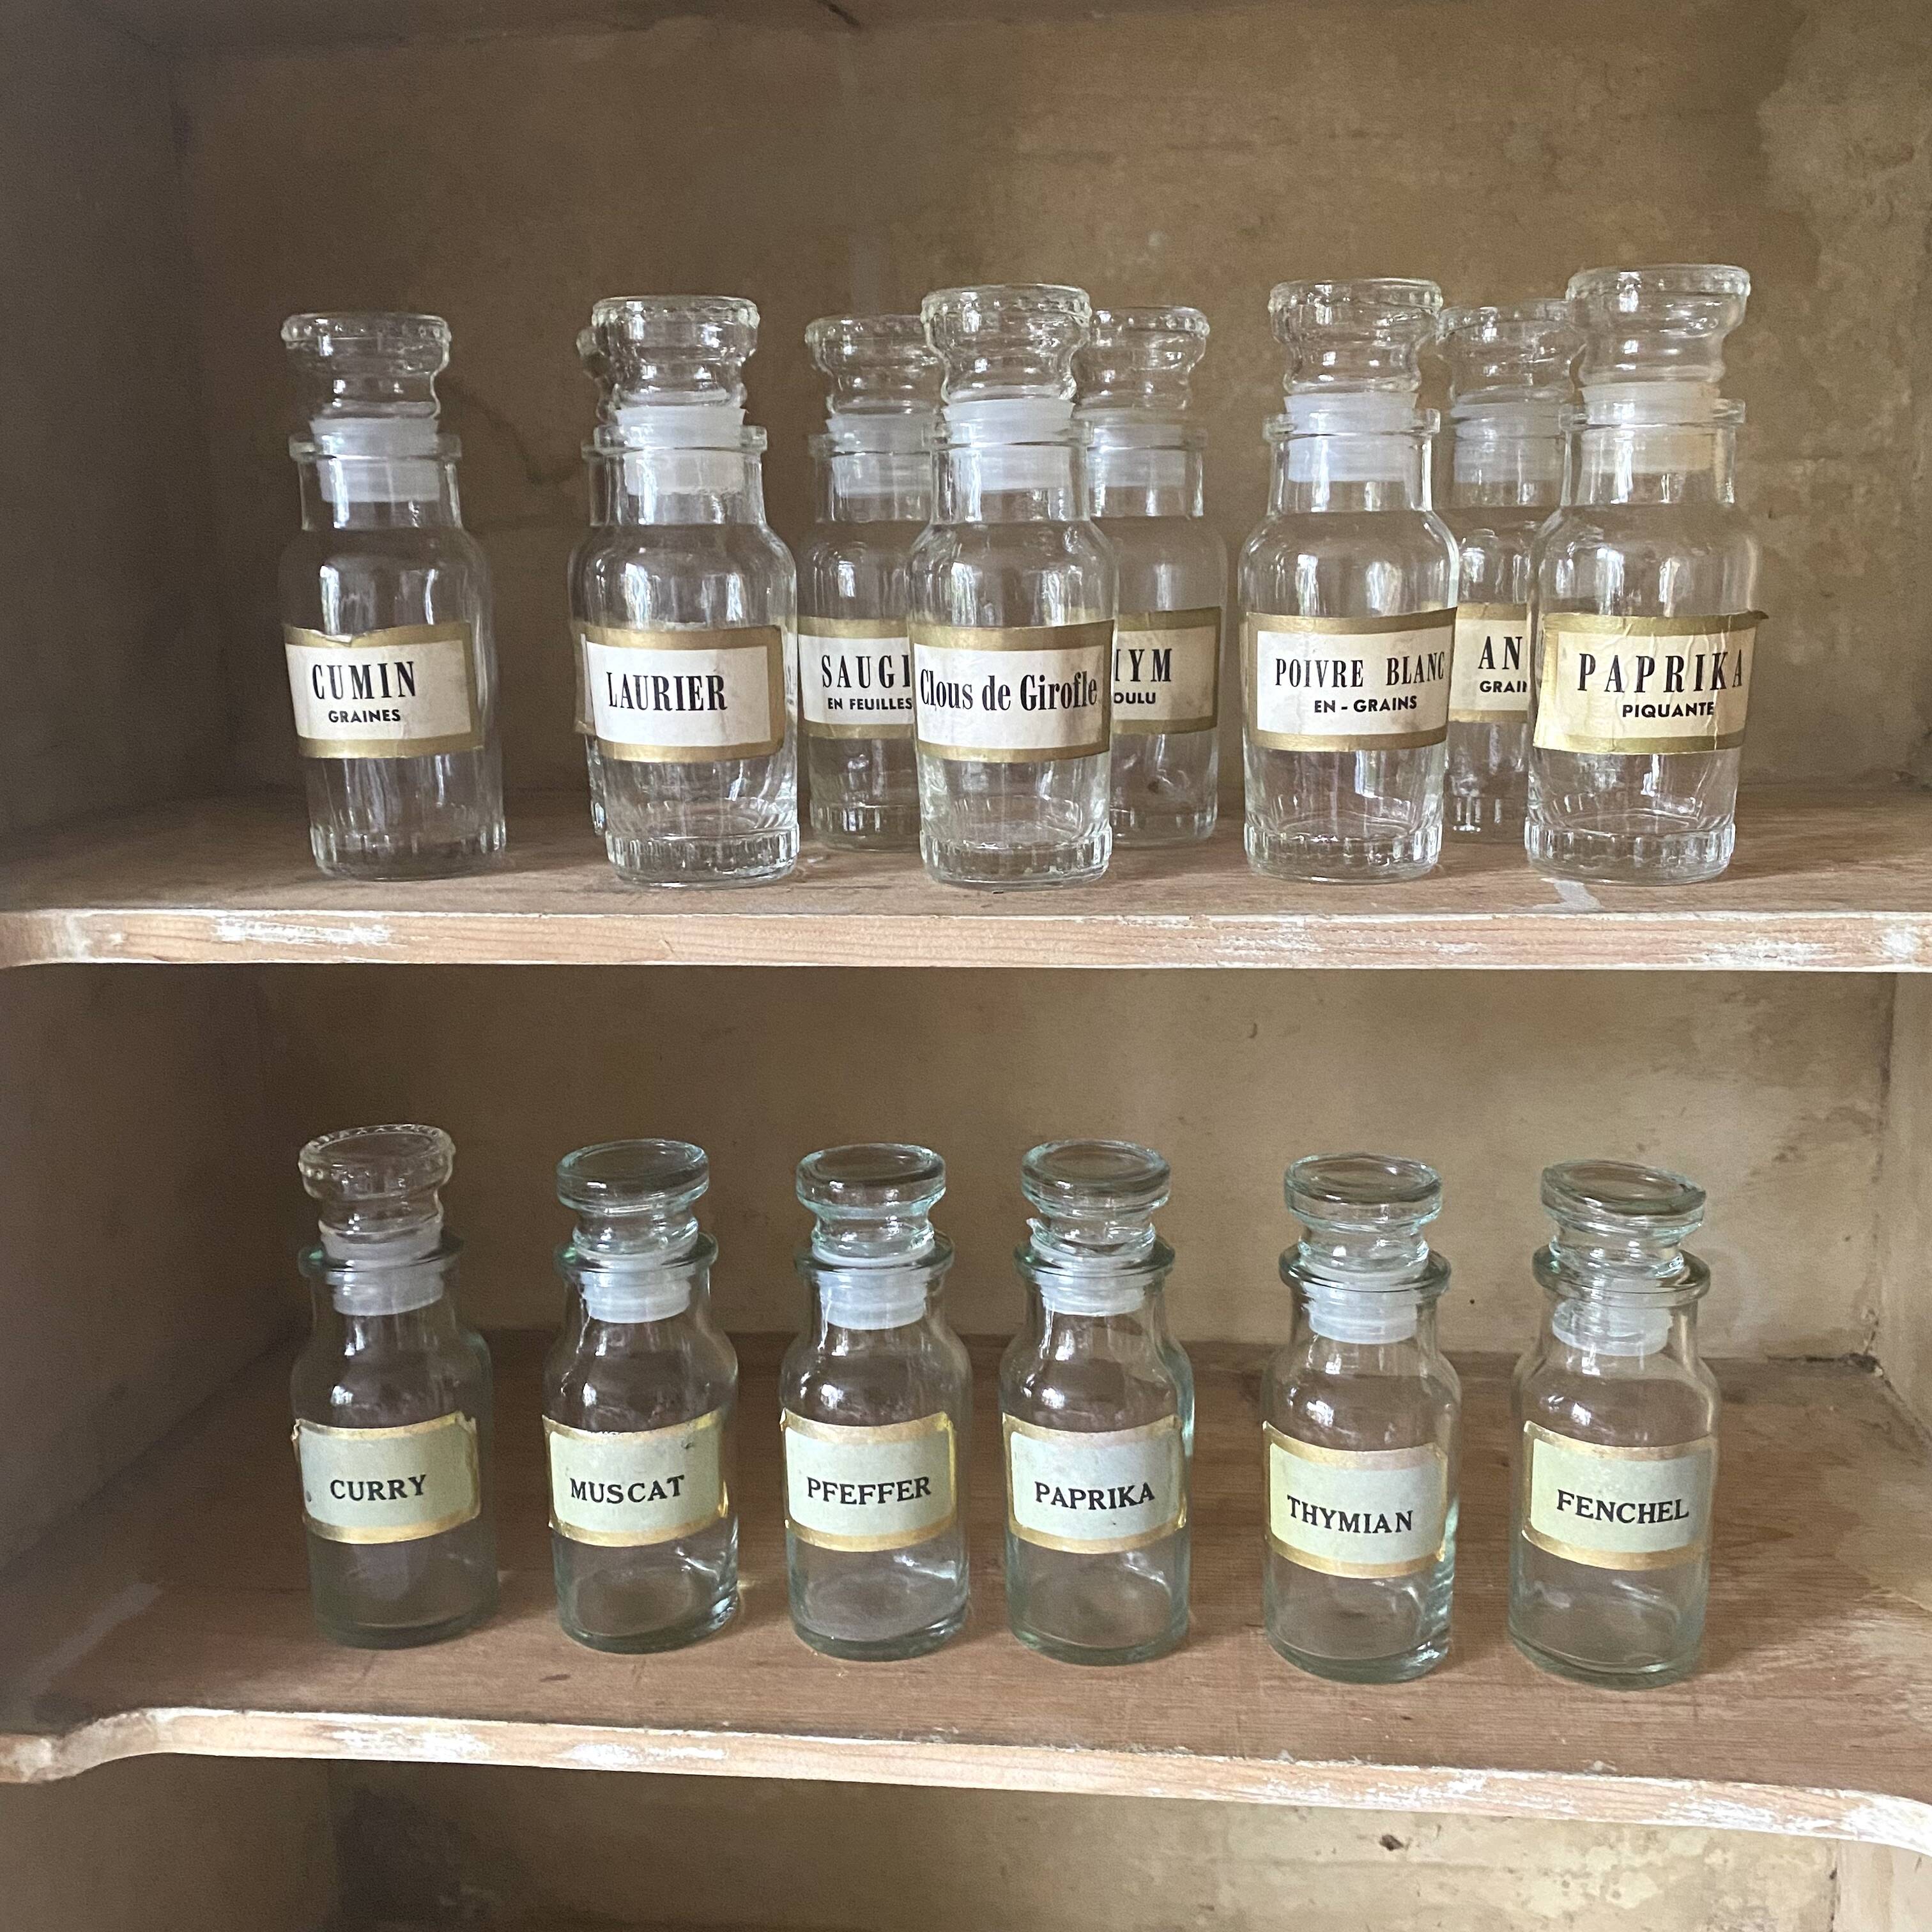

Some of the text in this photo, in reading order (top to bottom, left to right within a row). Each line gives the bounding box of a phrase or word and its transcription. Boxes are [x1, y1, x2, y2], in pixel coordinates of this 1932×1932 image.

[312, 661, 417, 700] CUMIN
[1275, 651, 1445, 688] POIVRE BLANC
[1577, 648, 1742, 693] PAPRIKA
[606, 671, 728, 712] LAURIER
[827, 697, 913, 710] EN FEUILLES
[920, 668, 1098, 712] Clous de Girofle
[328, 709, 401, 723] GRAINES
[1622, 701, 1714, 718] PIQUANTE
[330, 1474, 427, 1501] CURRY
[570, 1474, 685, 1504] MUSCAT
[807, 1476, 931, 1505] PFEFFER
[1034, 1481, 1155, 1510] PAPRIKA
[1287, 1494, 1414, 1534] THYMIAN
[1556, 1489, 1690, 1524] FENCHEL
